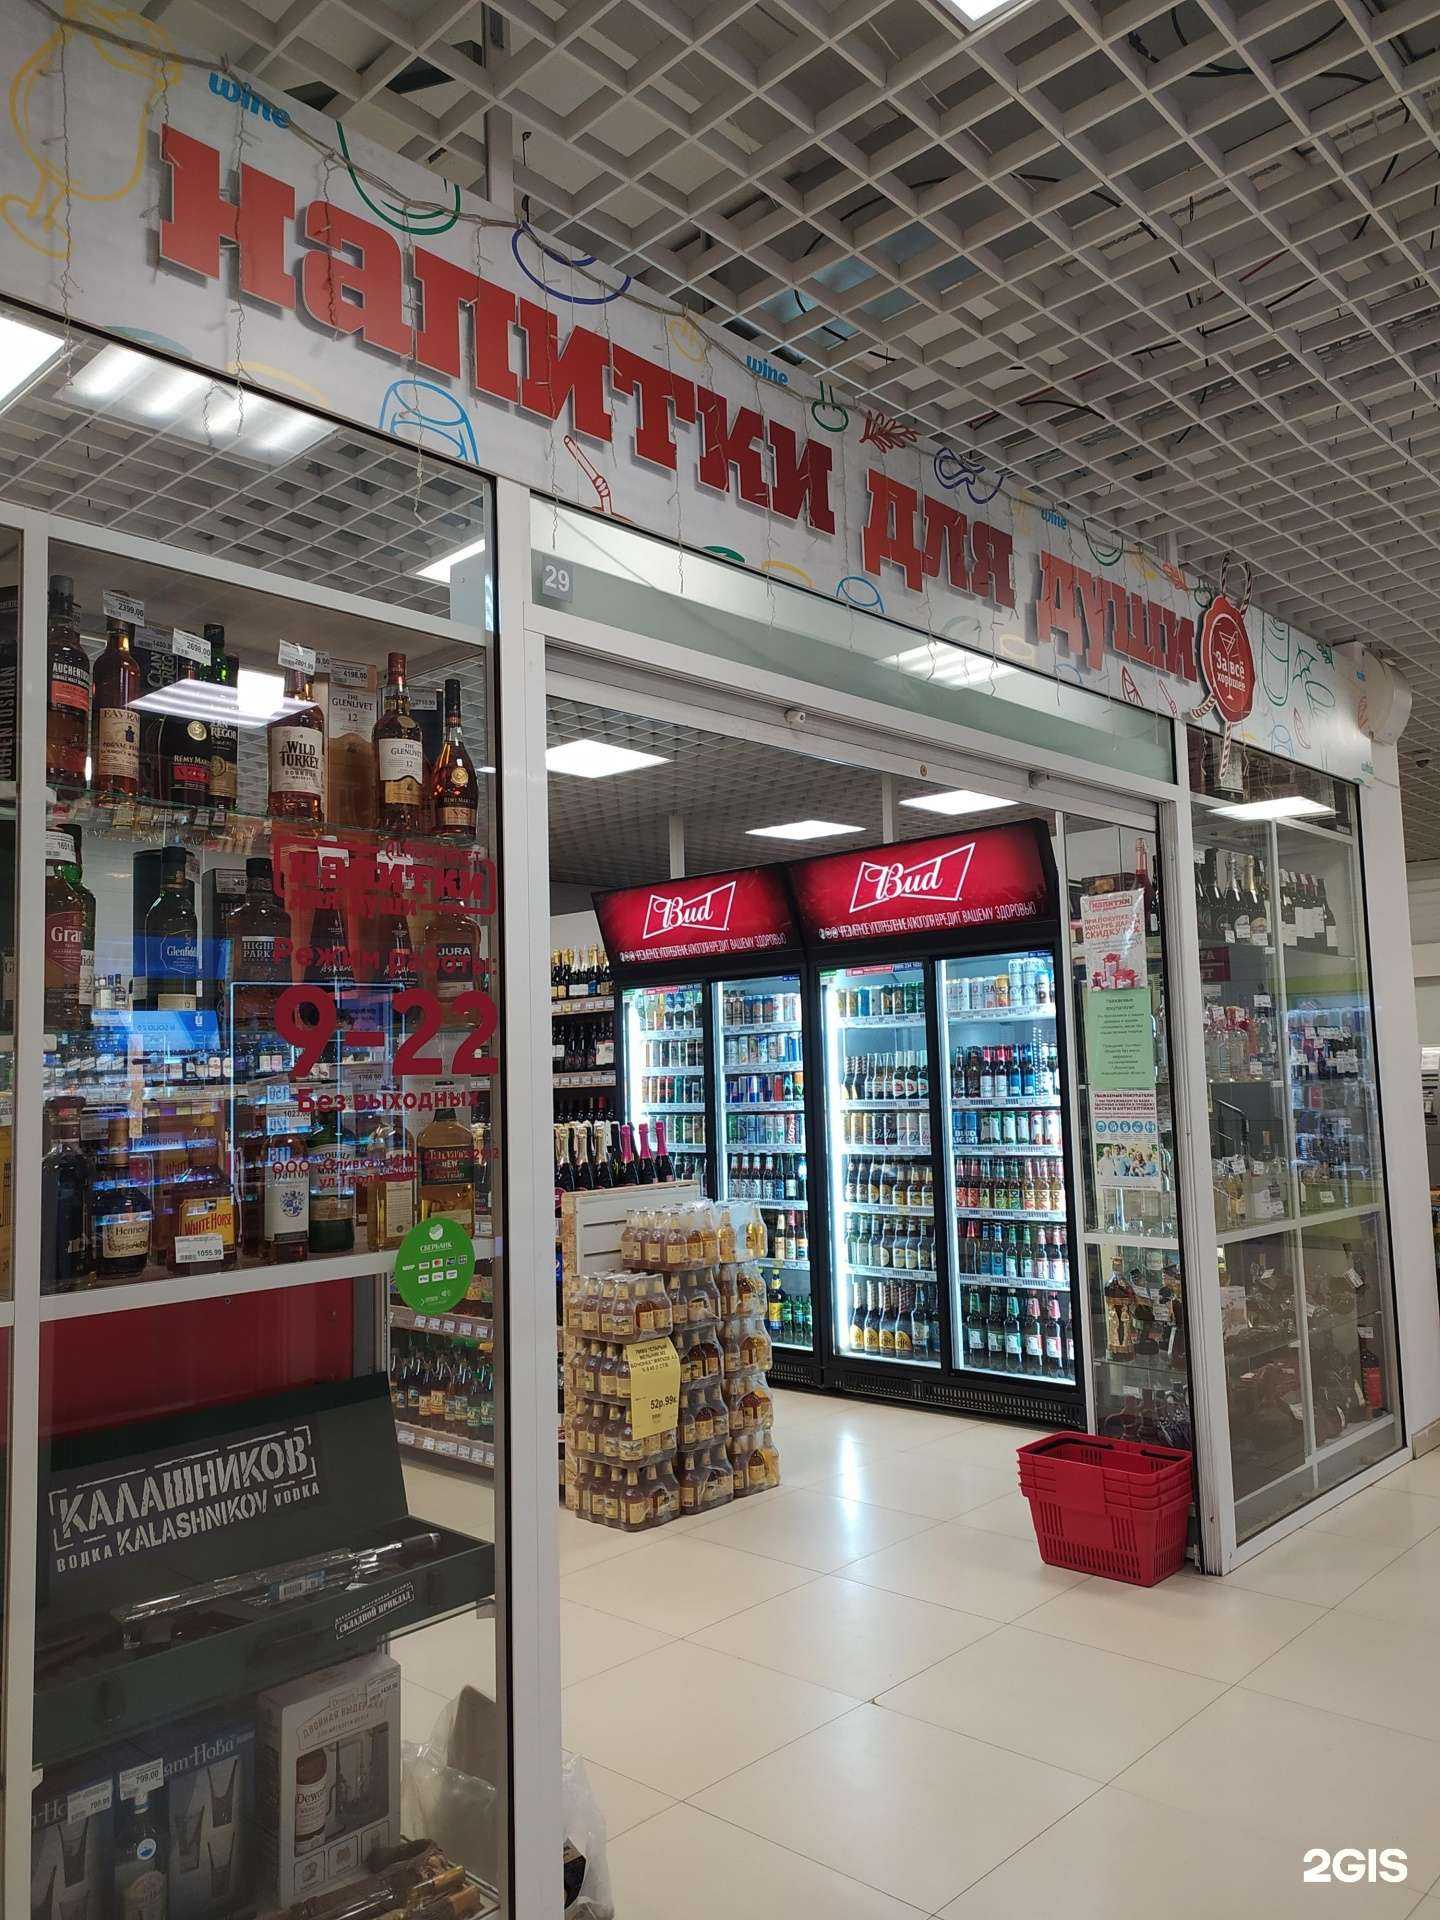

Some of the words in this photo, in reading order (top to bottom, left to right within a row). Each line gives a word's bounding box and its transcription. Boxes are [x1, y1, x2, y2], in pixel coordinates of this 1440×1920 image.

[208, 72, 292, 128] wine
[746, 354, 791, 386] wine
[544, 565, 570, 591] 29
[862, 467, 1016, 609] для
[1036, 549, 1198, 683] души
[1216, 650, 1228, 673] За
[1229, 660, 1245, 679] всё
[331, 698, 374, 711] GLENLIVET
[348, 713, 359, 722] 12
[0, 664, 16, 779] UCHENTOSHAN
[280, 750, 319, 769] TURKEY
[286, 740, 316, 756] WILD
[406, 760, 415, 768] 12
[864, 857, 943, 900] Bud
[653, 893, 714, 929] Bud
[963, 906, 993, 923] ВАШЕМУ
[995, 901, 1036, 921] ЗДОРОВЬЮ
[438, 946, 471, 956] JURA
[297, 1087, 346, 1113] Без
[353, 1089, 480, 1112] выходных
[272, 1159, 310, 1174] ООО
[184, 1219, 210, 1236] WHITE
[59, 1436, 309, 1539] КАЛАШНИКОВ
[116, 1489, 268, 1556] KALASHNIKOV
[273, 1481, 320, 1506] VODKA
[56, 1544, 113, 1573] ВОДКА
